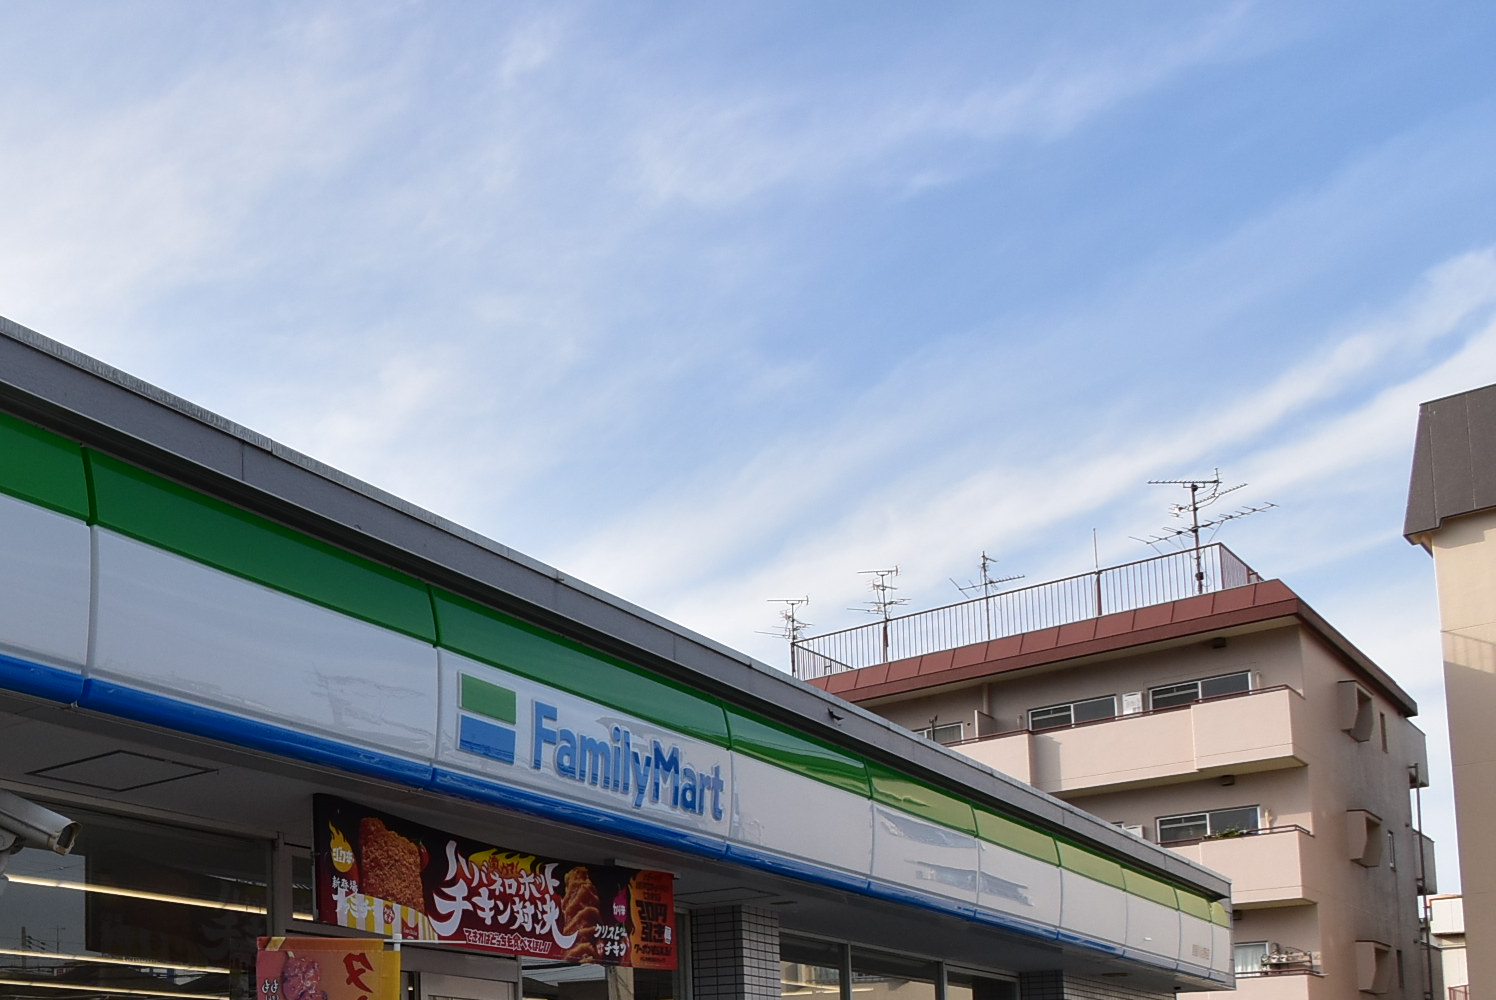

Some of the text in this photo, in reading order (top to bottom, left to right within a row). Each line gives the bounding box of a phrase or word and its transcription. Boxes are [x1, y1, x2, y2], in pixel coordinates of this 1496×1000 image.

[531, 699, 724, 820] FamilyMart
[445, 840, 560, 900] ハバネロホット
[428, 879, 578, 949] チキン対決
